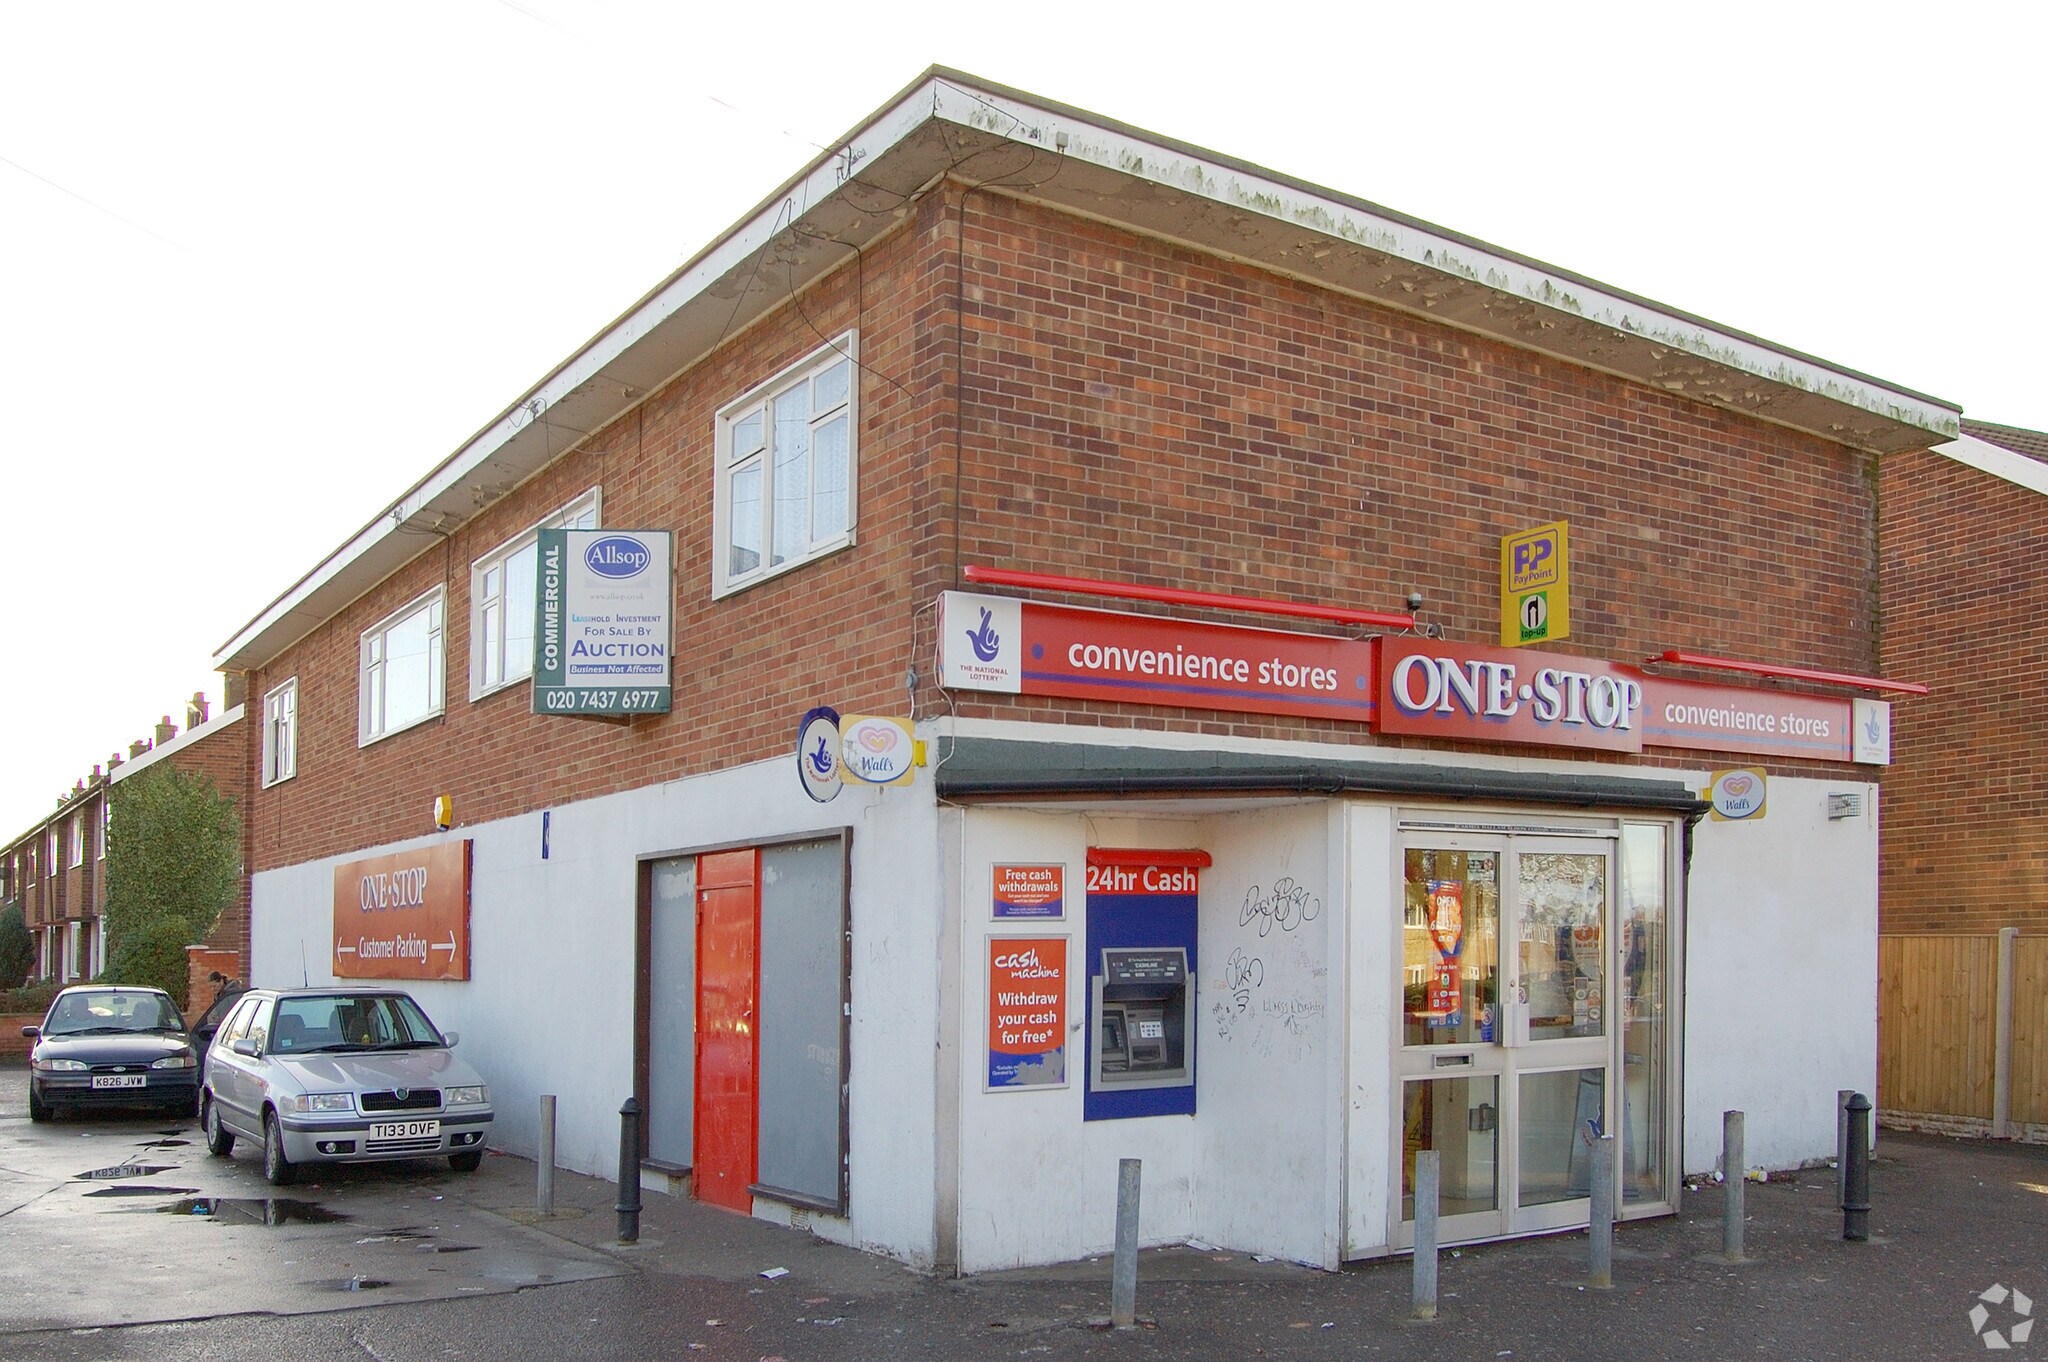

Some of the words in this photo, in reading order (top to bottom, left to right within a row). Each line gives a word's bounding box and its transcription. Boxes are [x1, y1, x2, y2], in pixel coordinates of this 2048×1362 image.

[589, 545, 646, 568] Allsop
[1513, 568, 1553, 585] PayPoint
[544, 545, 559, 671] COMMERCIAL
[1521, 627, 1546, 638] top-up
[571, 639, 664, 657] AUCTION
[570, 665, 606, 673] Business
[607, 665, 625, 673] Not
[626, 665, 662, 673] Affected
[960, 664, 973, 672] THE
[974, 666, 1009, 675] NATIONAL
[1068, 642, 1249, 684] convenience
[1258, 656, 1338, 692] stores
[970, 673, 999, 682] LOTTERY
[547, 691, 575, 709] 020
[580, 691, 617, 709] 7437
[621, 691, 659, 709] 6977
[1665, 704, 1775, 733] convenience
[1780, 712, 1829, 737] stores
[861, 756, 894, 772] Wall's
[1725, 798, 1750, 811] Wall's
[1005, 869, 1027, 880] Free
[1029, 869, 1052, 880] cash
[1086, 866, 1138, 891] 24hr
[1143, 866, 1196, 891] Cash
[998, 881, 1059, 892] withdrawals
[359, 936, 394, 959] Customer
[396, 932, 427, 964] Parking
[994, 948, 1039, 968] cash
[1011, 965, 1059, 979] machine
[998, 991, 1058, 1006] Withdraw
[998, 1014, 1026, 1028] your
[1029, 1010, 1057, 1024] cash
[1002, 1031, 1020, 1044] for
[96, 1077, 122, 1087] K826
[375, 1124, 406, 1137] T133
[409, 1122, 436, 1135] OVF
